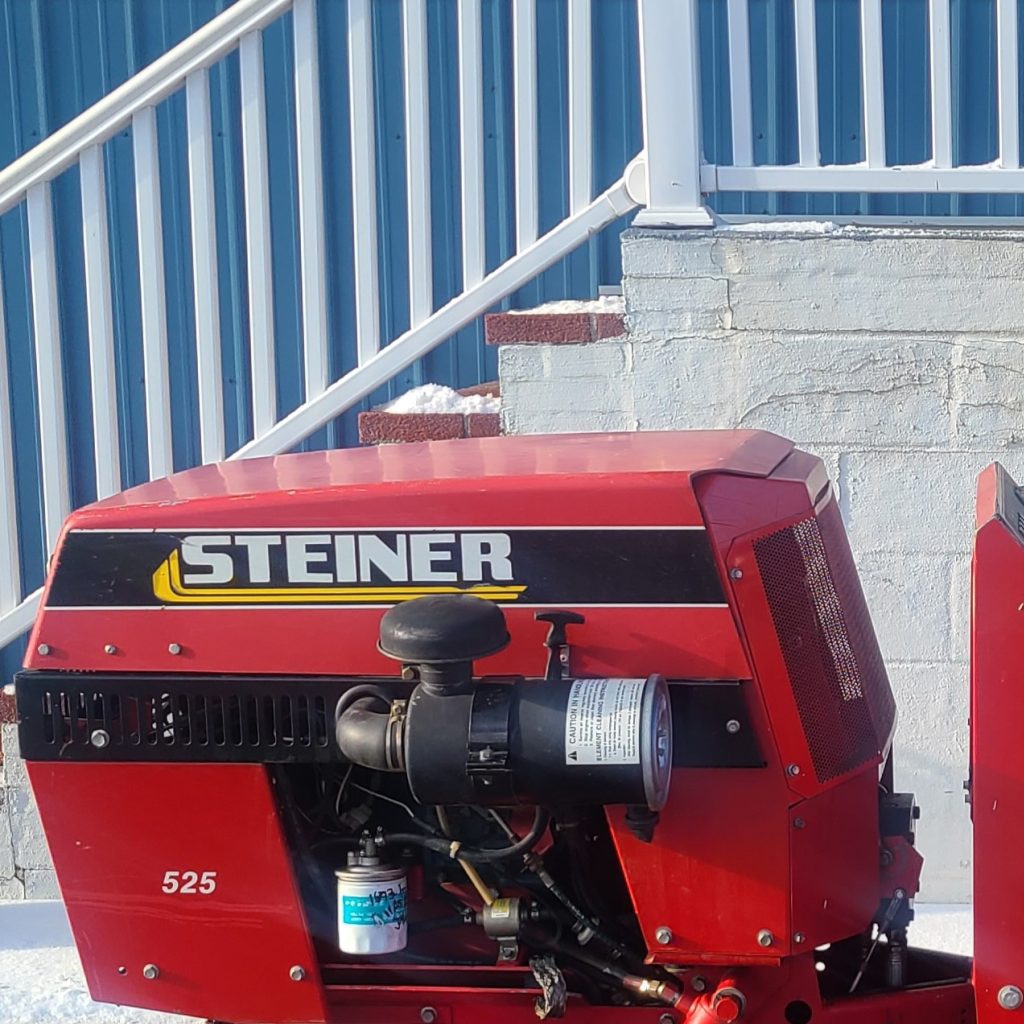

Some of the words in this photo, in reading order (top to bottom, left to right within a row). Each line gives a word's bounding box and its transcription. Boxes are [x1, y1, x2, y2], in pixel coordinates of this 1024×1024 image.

[181, 533, 514, 584] STEINER
[568, 708, 577, 744] CAUTION
[162, 871, 216, 895] 525
